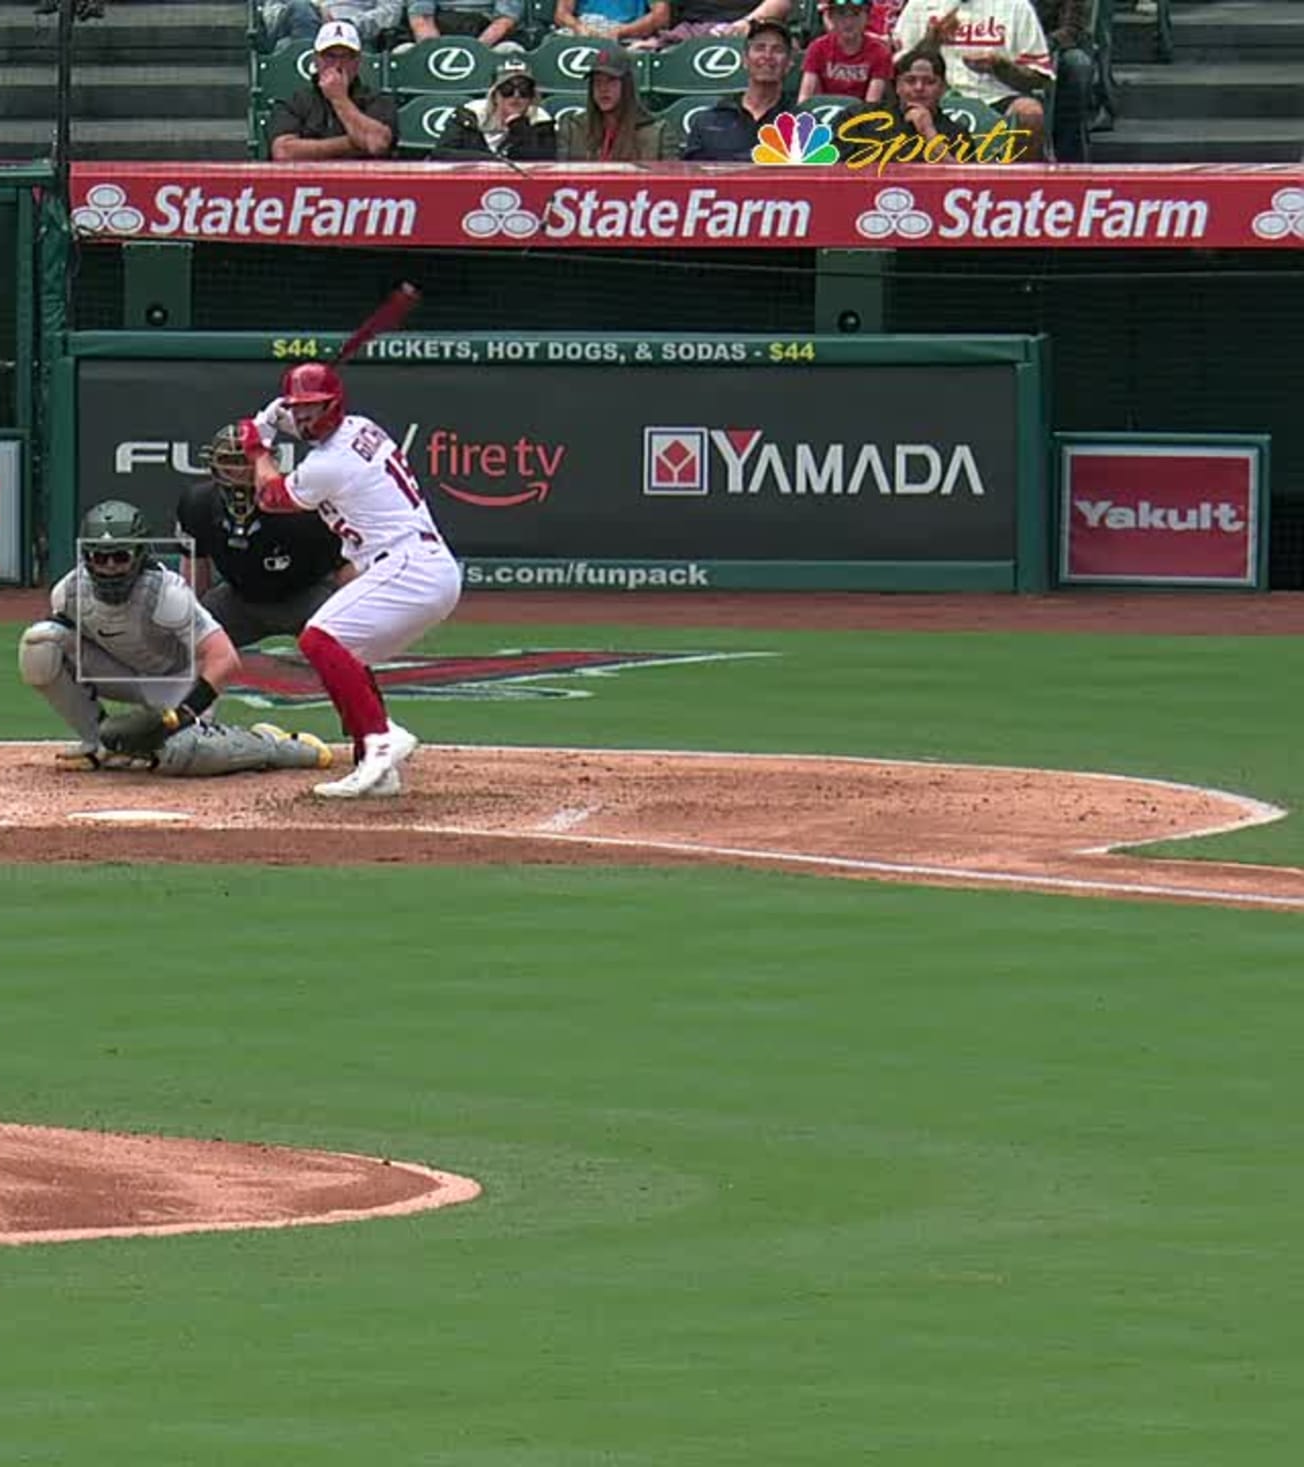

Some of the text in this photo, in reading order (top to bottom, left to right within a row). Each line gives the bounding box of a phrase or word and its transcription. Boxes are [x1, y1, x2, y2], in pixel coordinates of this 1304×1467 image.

[272, 338, 318, 359] $44
[365, 340, 479, 362] TICKETS,
[487, 341, 539, 360] HOT
[548, 342, 627, 363] DOGS,
[634, 343, 653, 361] &
[661, 342, 746, 361] SODAS
[769, 341, 815, 362] $44
[427, 430, 506, 476] fire
[518, 434, 565, 476] tv
[710, 429, 985, 495] YAMADA
[1074, 501, 1245, 532] Yakult
